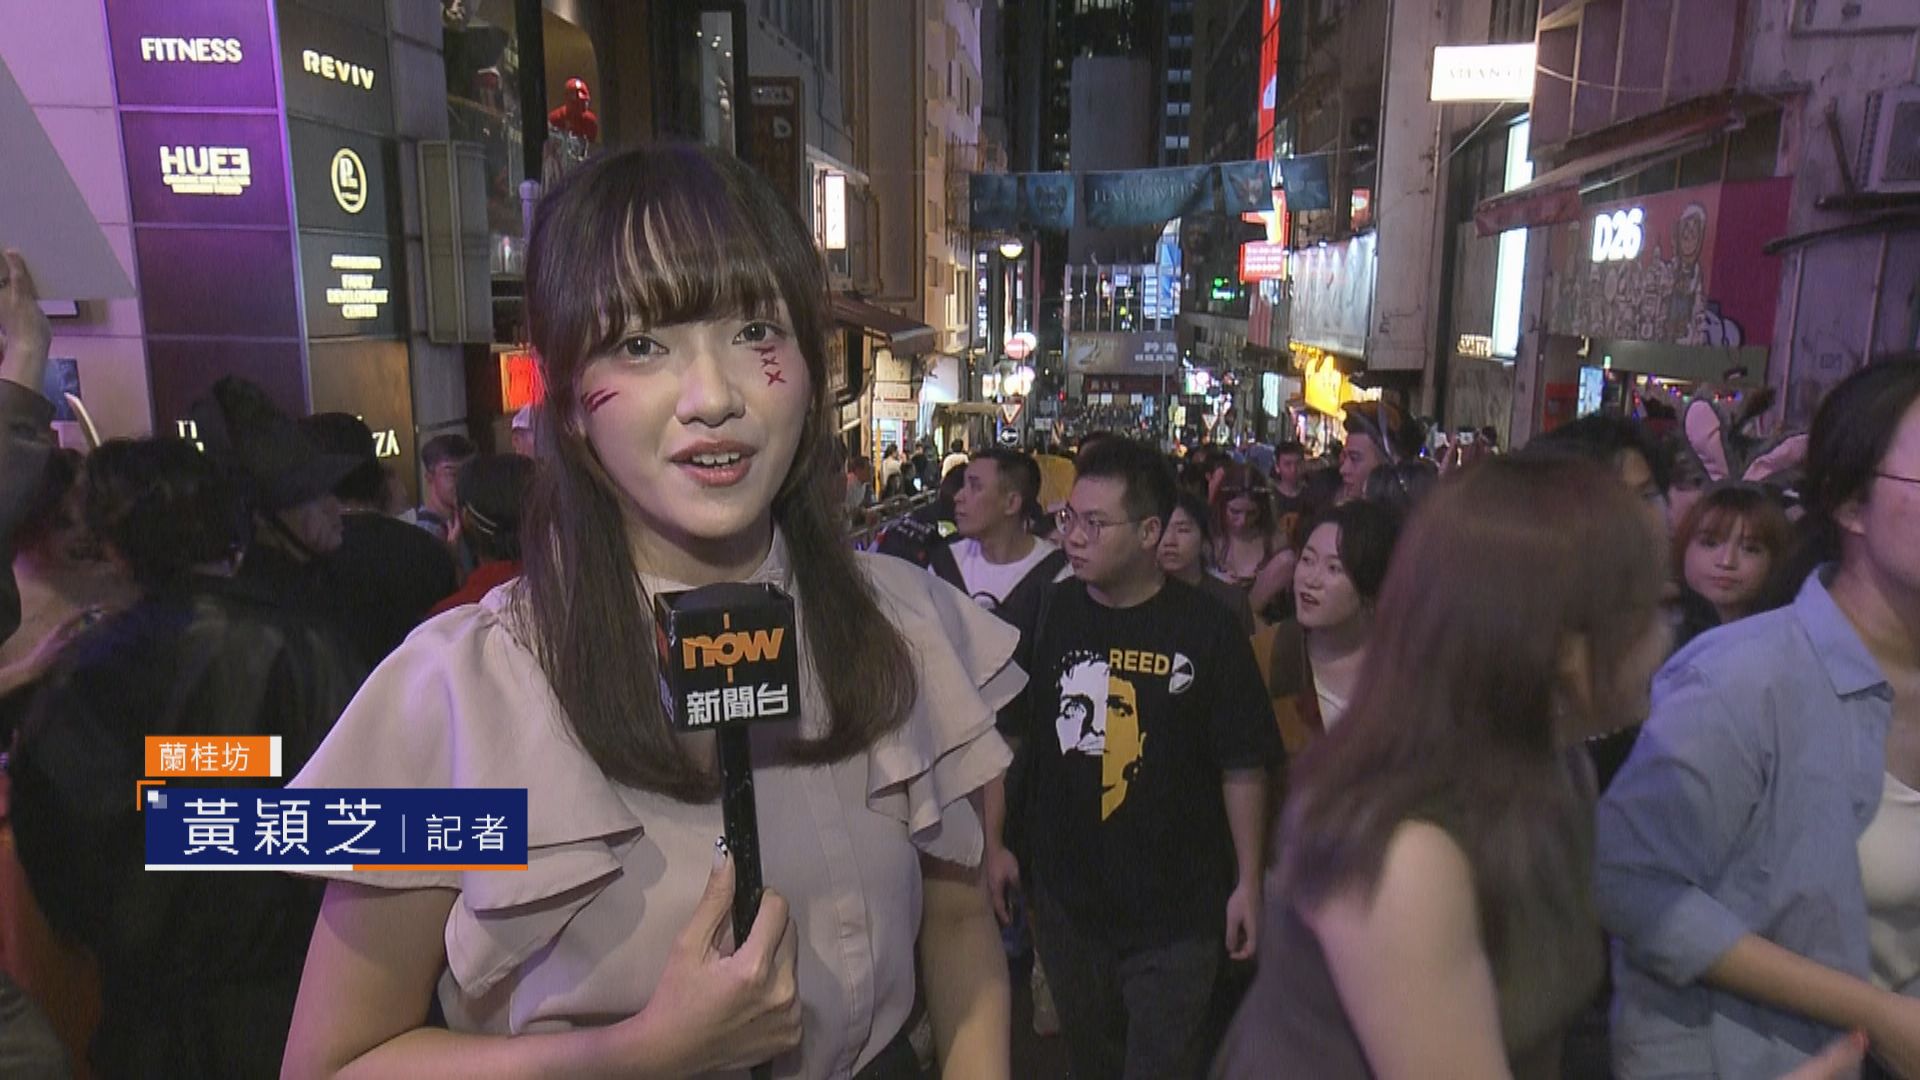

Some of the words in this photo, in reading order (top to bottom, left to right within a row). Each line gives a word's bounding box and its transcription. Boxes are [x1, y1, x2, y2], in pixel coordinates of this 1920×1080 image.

[140, 37, 243, 63] FITNESS
[302, 49, 375, 90] REVIV
[1591, 207, 1644, 263] D26
[681, 627, 785, 670] now
[1109, 648, 1170, 675] REED
[686, 682, 789, 726] 新聞台
